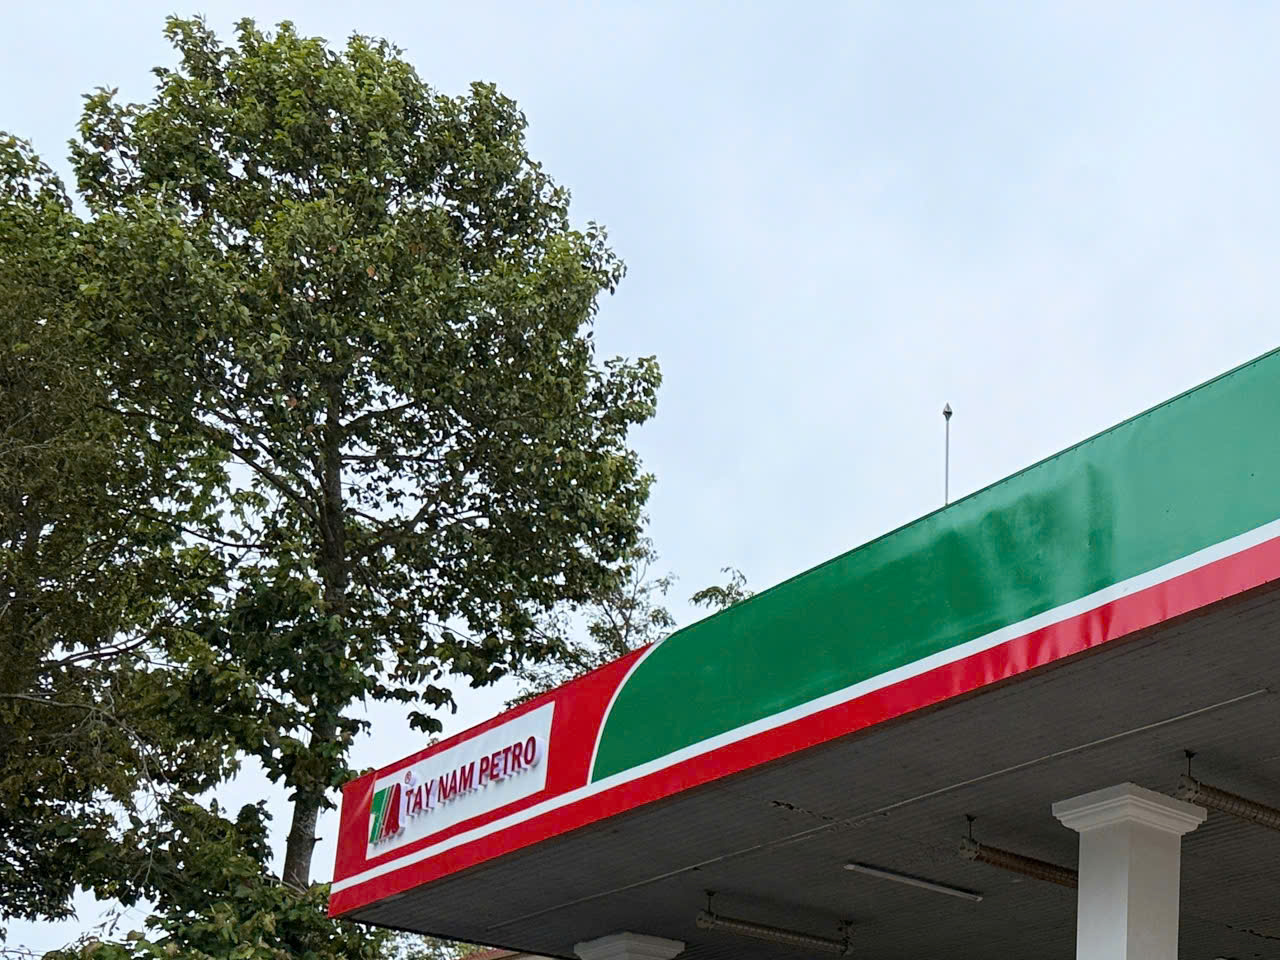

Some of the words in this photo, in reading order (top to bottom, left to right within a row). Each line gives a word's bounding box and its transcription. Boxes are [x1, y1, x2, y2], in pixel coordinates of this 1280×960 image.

[405, 779, 434, 816] TAY
[438, 762, 475, 803] NAM
[479, 736, 538, 786] PETRO
